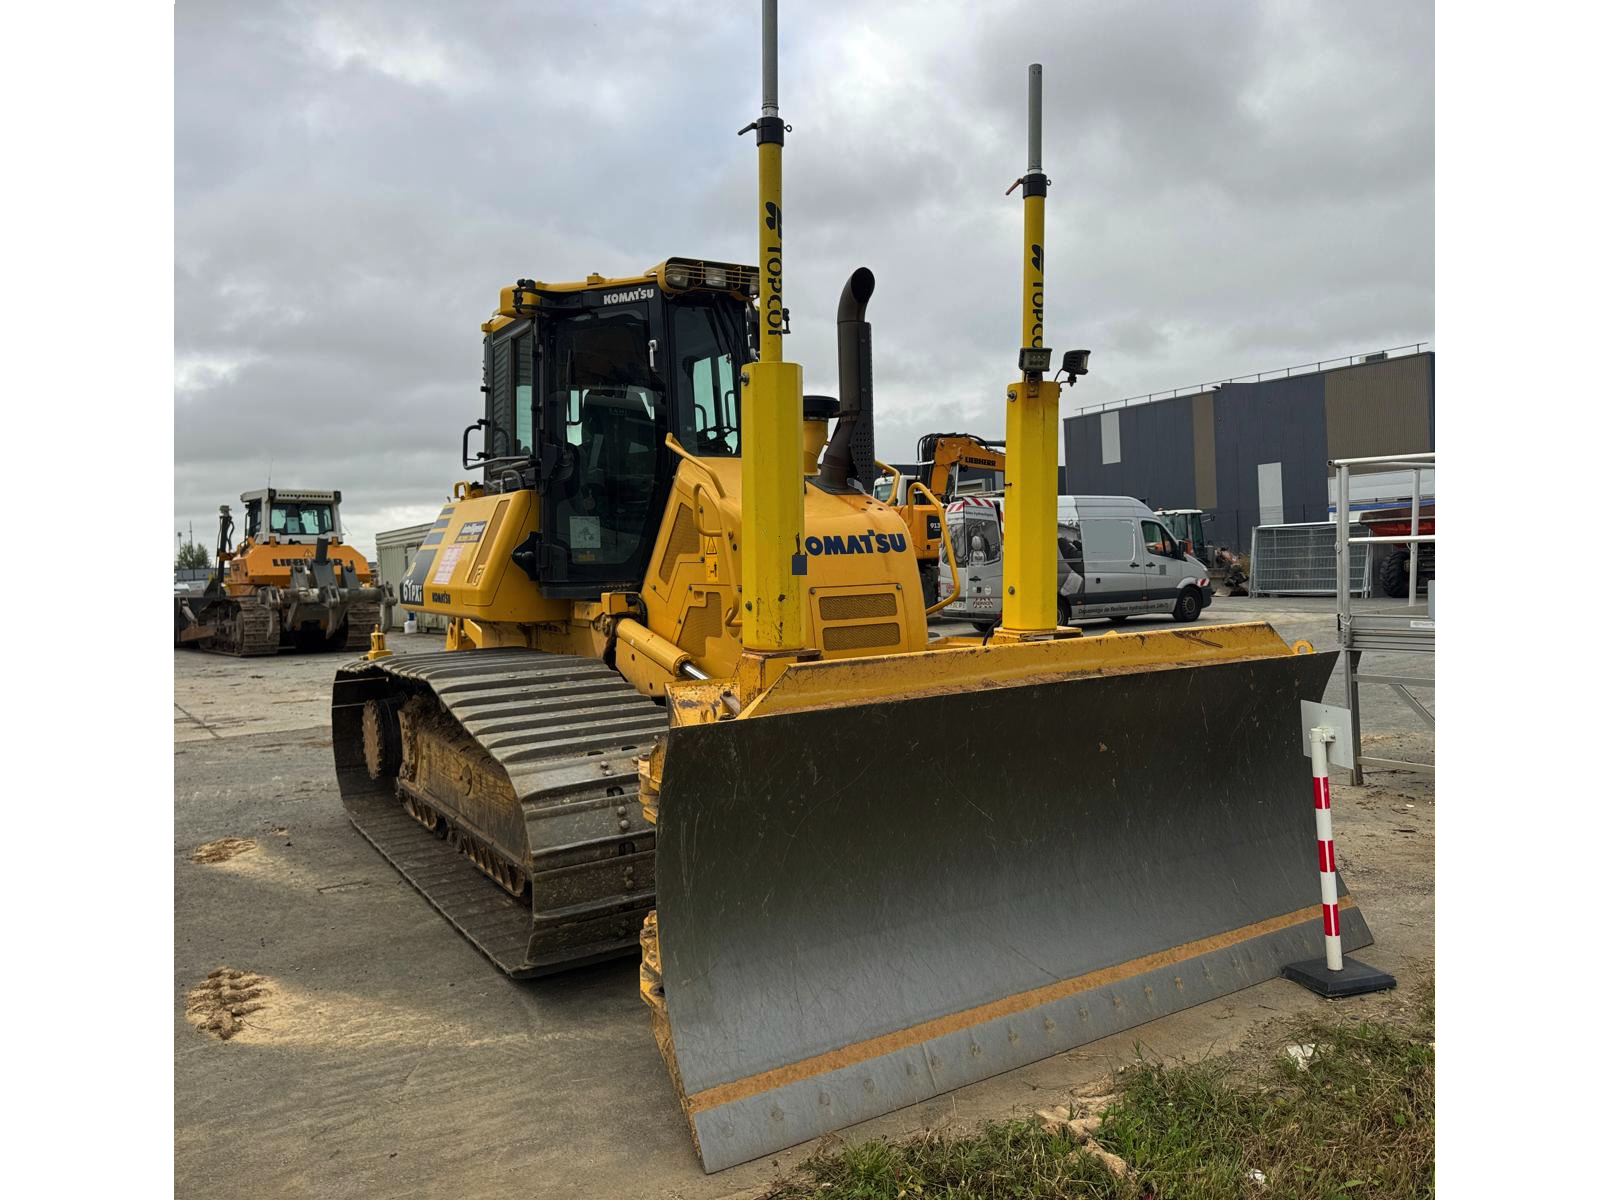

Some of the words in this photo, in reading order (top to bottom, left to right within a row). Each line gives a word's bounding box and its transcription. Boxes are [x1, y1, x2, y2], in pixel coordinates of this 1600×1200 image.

[603, 287, 655, 305] KOMATSU
[1031, 282, 1044, 348] TOPCO
[965, 457, 996, 466] LIEBHERR
[804, 529, 907, 556] OMATSU
[432, 591, 451, 605] KOMATSU
